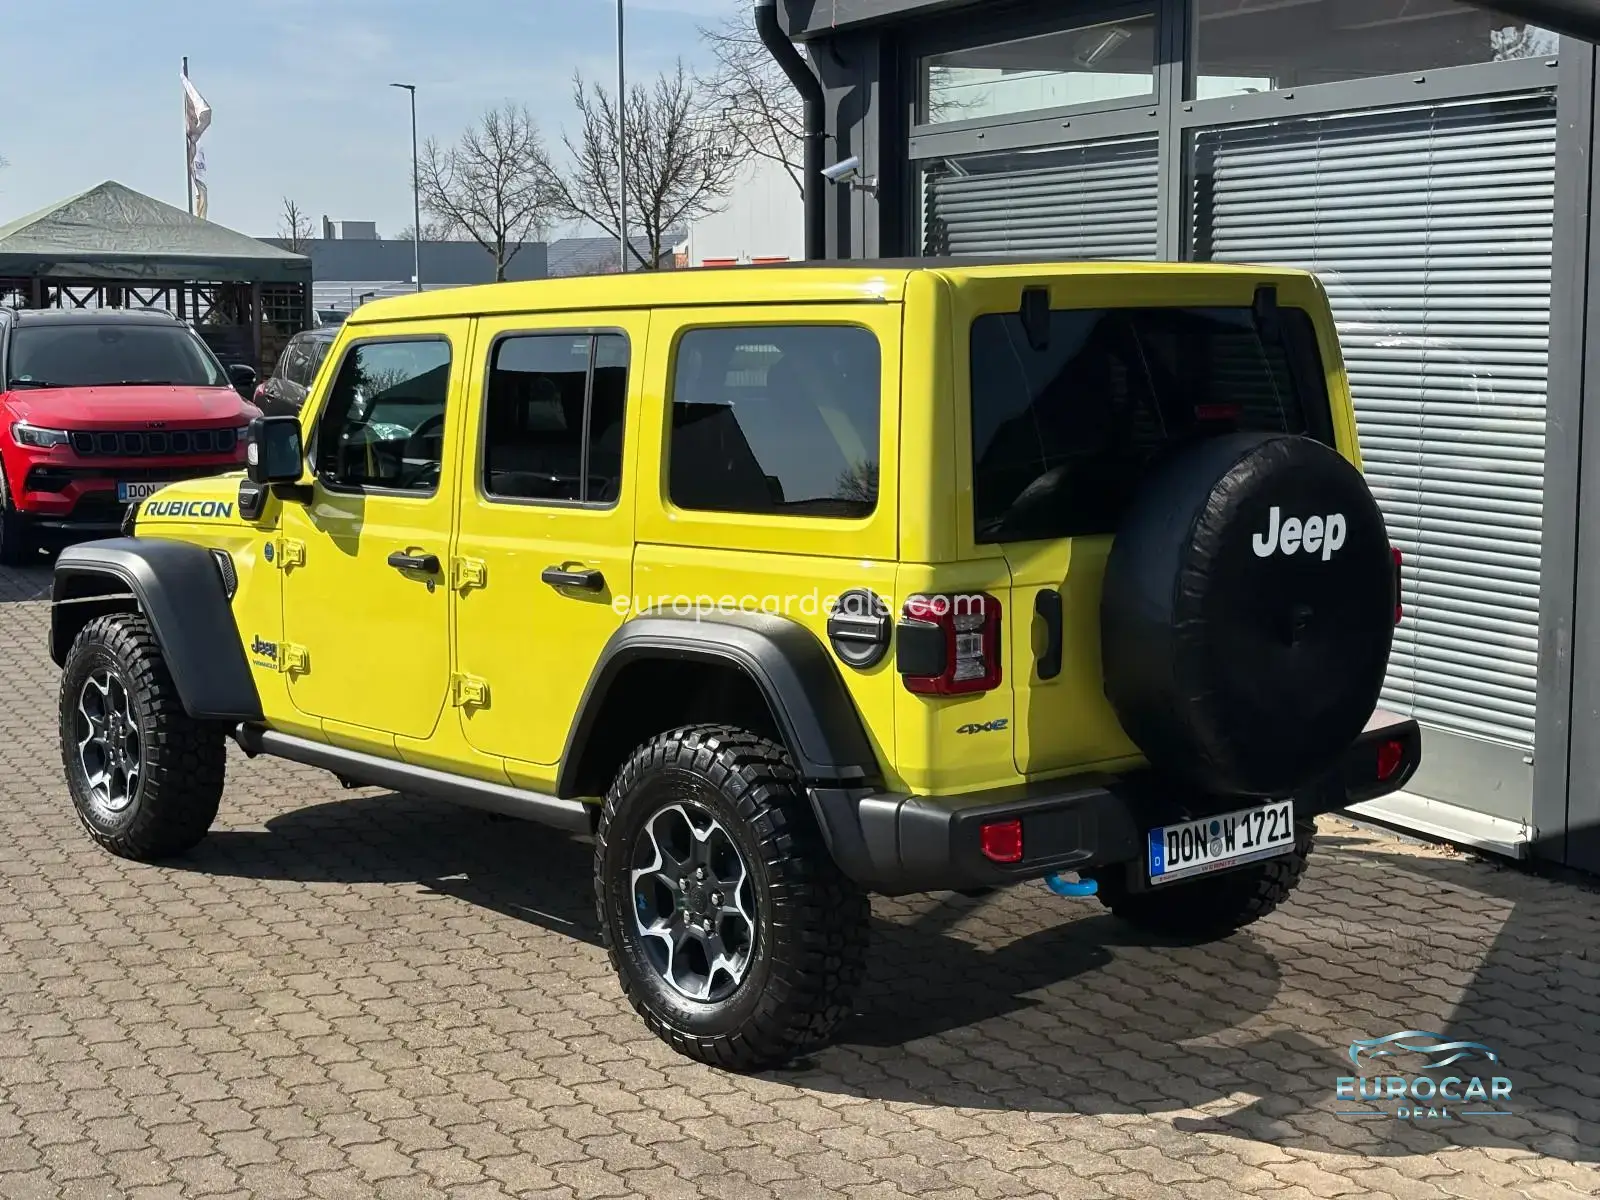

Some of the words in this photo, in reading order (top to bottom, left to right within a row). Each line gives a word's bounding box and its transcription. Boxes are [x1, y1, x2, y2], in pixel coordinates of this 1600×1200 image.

[128, 484, 156, 498] DON
[143, 501, 235, 519] RUBICON
[1252, 506, 1347, 561] Jeep
[251, 634, 278, 661] Jeep
[1166, 823, 1208, 866] DON
[1223, 815, 1236, 852] W
[1241, 805, 1292, 848] 1721
[1154, 856, 1161, 867] D
